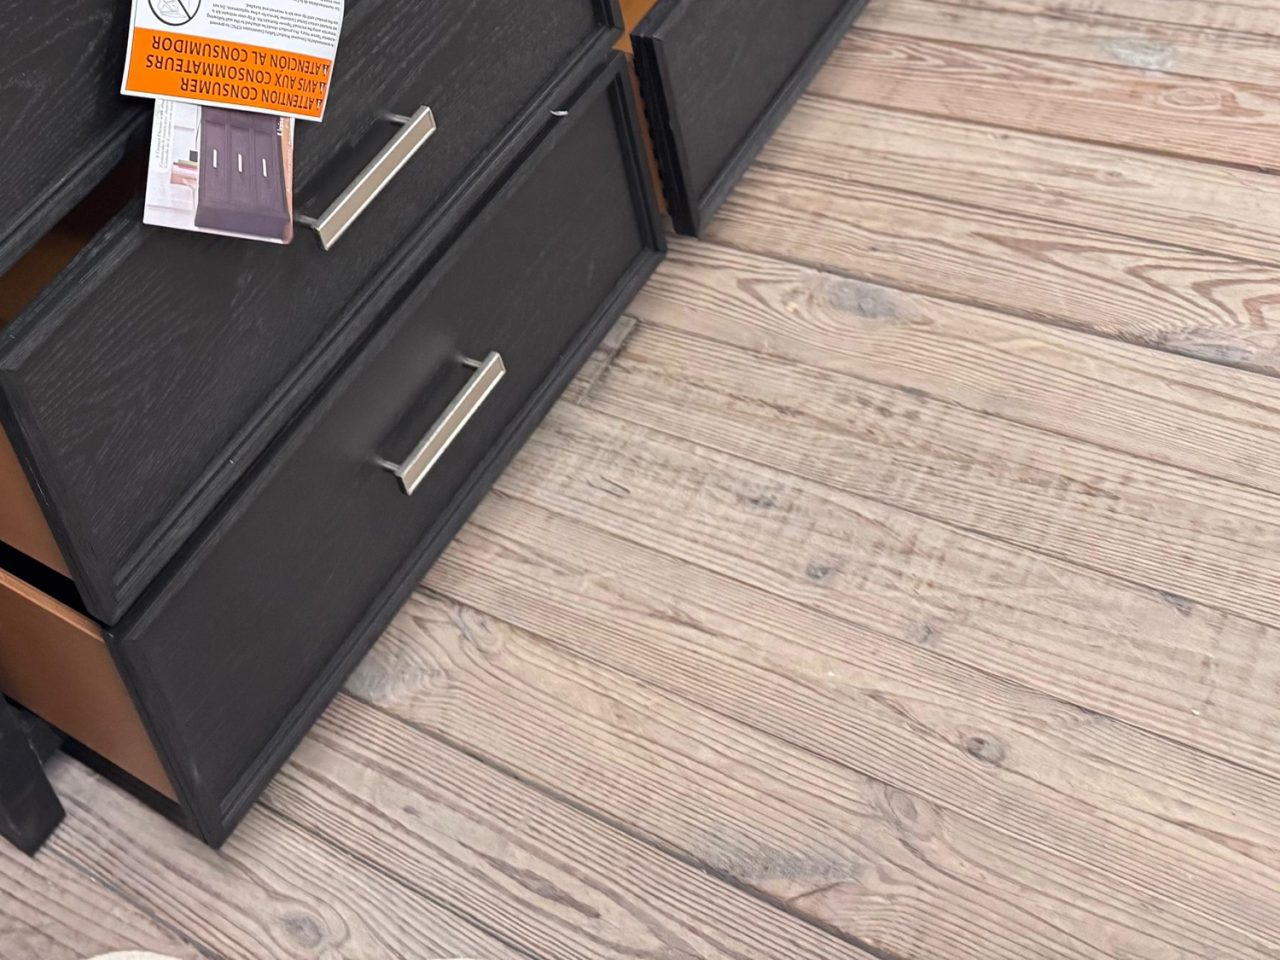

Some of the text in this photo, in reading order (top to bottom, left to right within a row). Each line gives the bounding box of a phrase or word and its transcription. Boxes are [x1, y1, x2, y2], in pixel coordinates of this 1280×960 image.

[145, 54, 317, 92] AVIS AUX CONSOMMATEURS
[151, 35, 321, 75] ATENCIÓN AL CONSUMIDOR
[179, 77, 314, 109] ATTENTION CONSUMER
